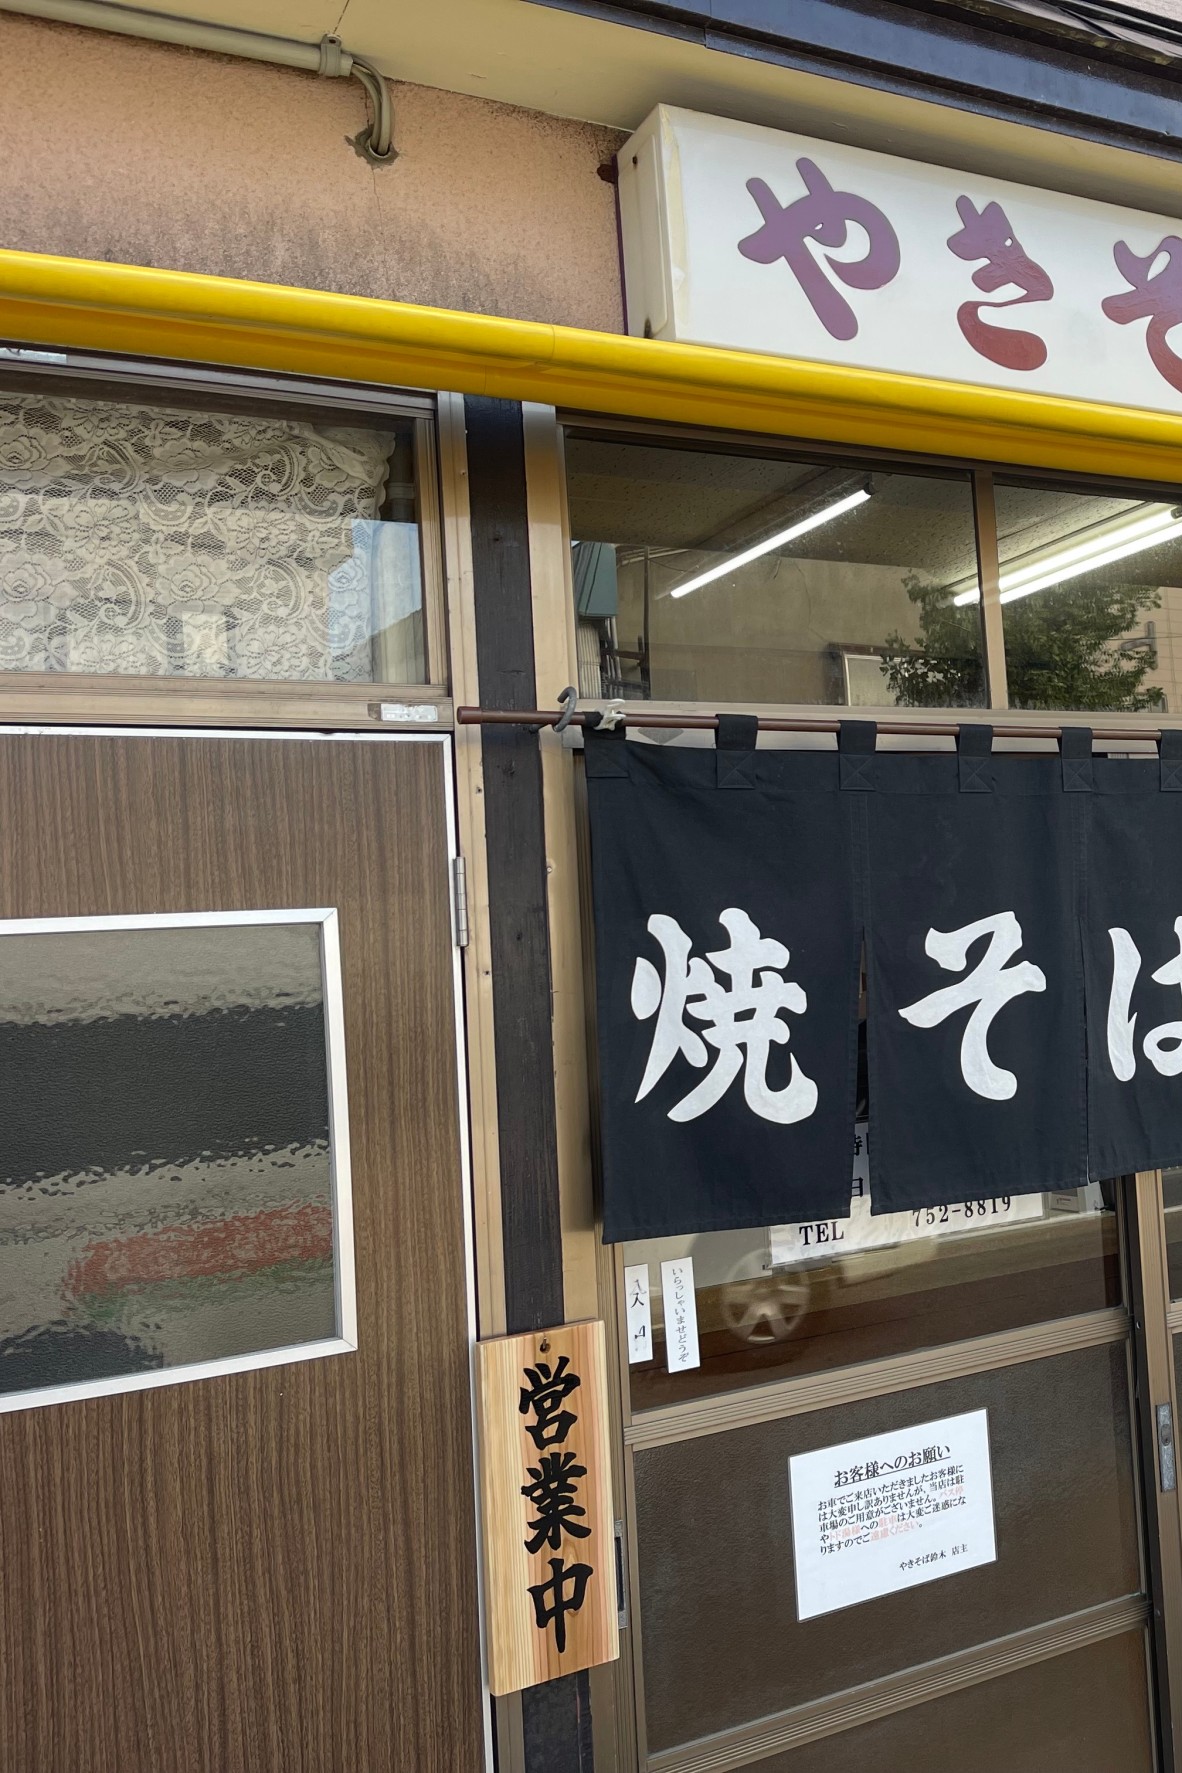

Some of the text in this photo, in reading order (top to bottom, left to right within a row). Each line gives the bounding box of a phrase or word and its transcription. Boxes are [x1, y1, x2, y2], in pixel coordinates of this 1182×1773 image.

[799, 1196, 1011, 1246] TEL 752-8819
[672, 1267, 690, 1363] いらっしゃいませどうぞ
[817, 1464, 964, 1511] お車でご来店いただきましたお客様に
[834, 1445, 951, 1487] お客様へのお願い
[518, 1355, 594, 1655] 営業中
